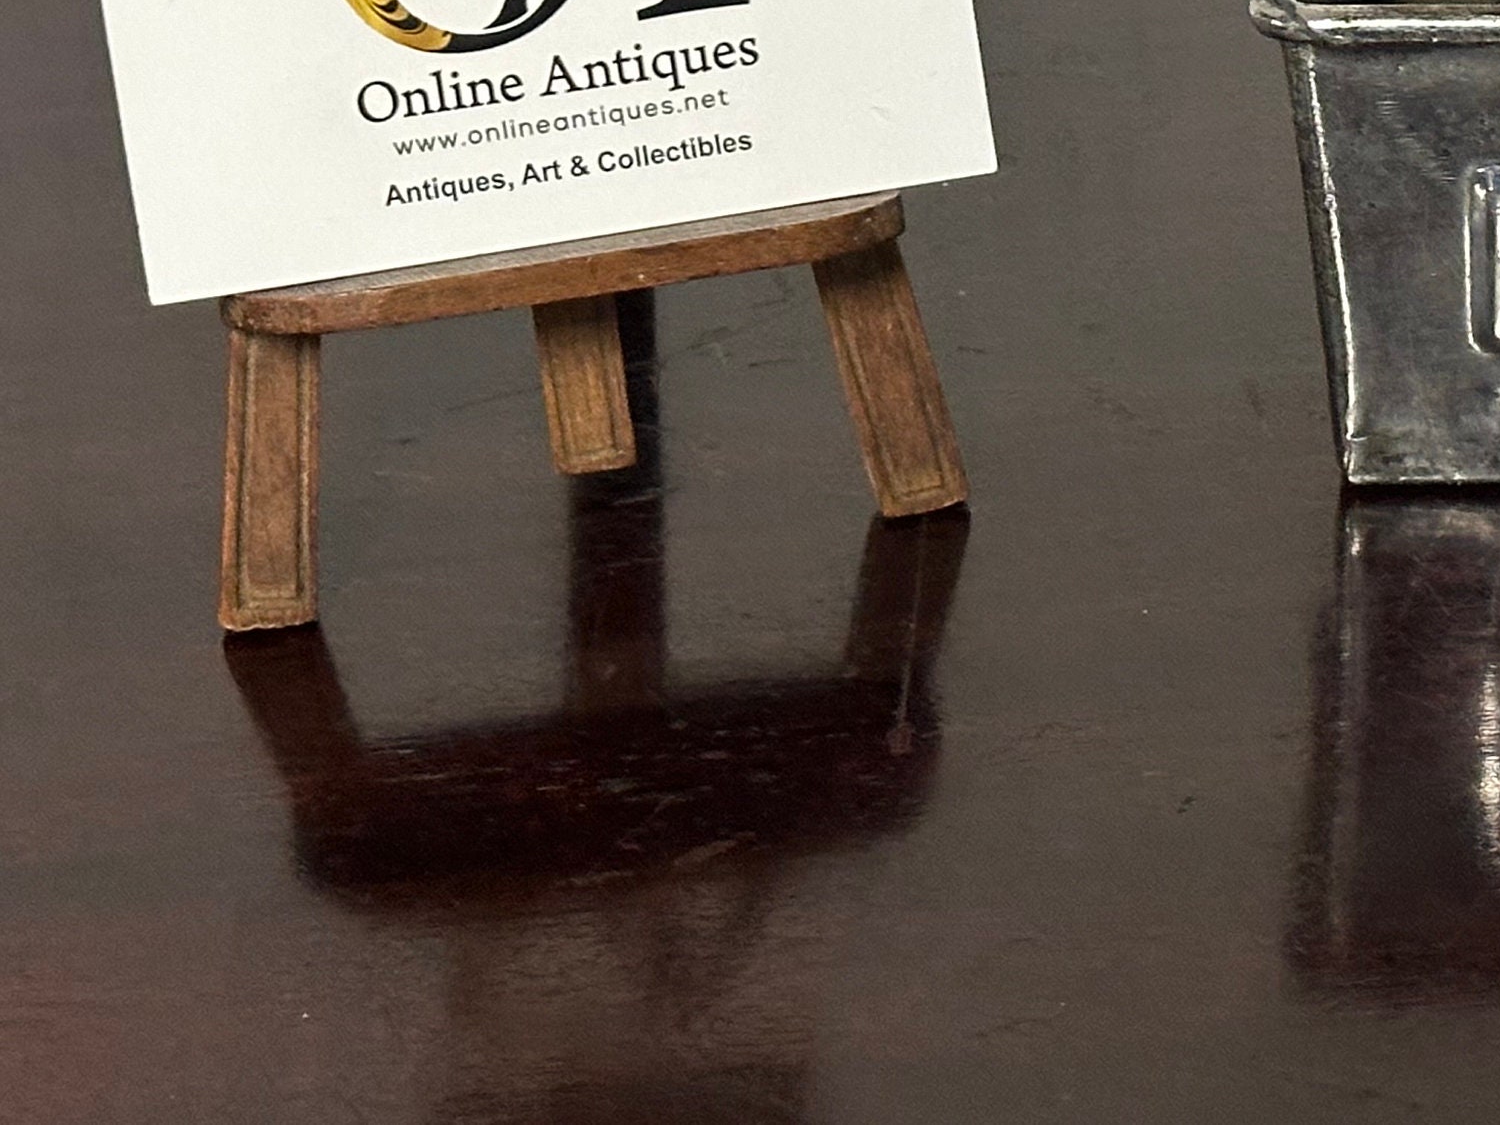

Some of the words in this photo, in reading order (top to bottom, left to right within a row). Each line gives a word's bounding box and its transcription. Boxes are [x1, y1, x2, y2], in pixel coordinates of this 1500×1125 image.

[357, 71, 525, 123] Online
[539, 36, 759, 91] Antiques
[393, 89, 730, 156] www.onlineantiques.net
[385, 168, 515, 207] Antiques,
[522, 160, 562, 186] Art
[571, 156, 590, 177] &
[597, 131, 753, 173] Collectibles
